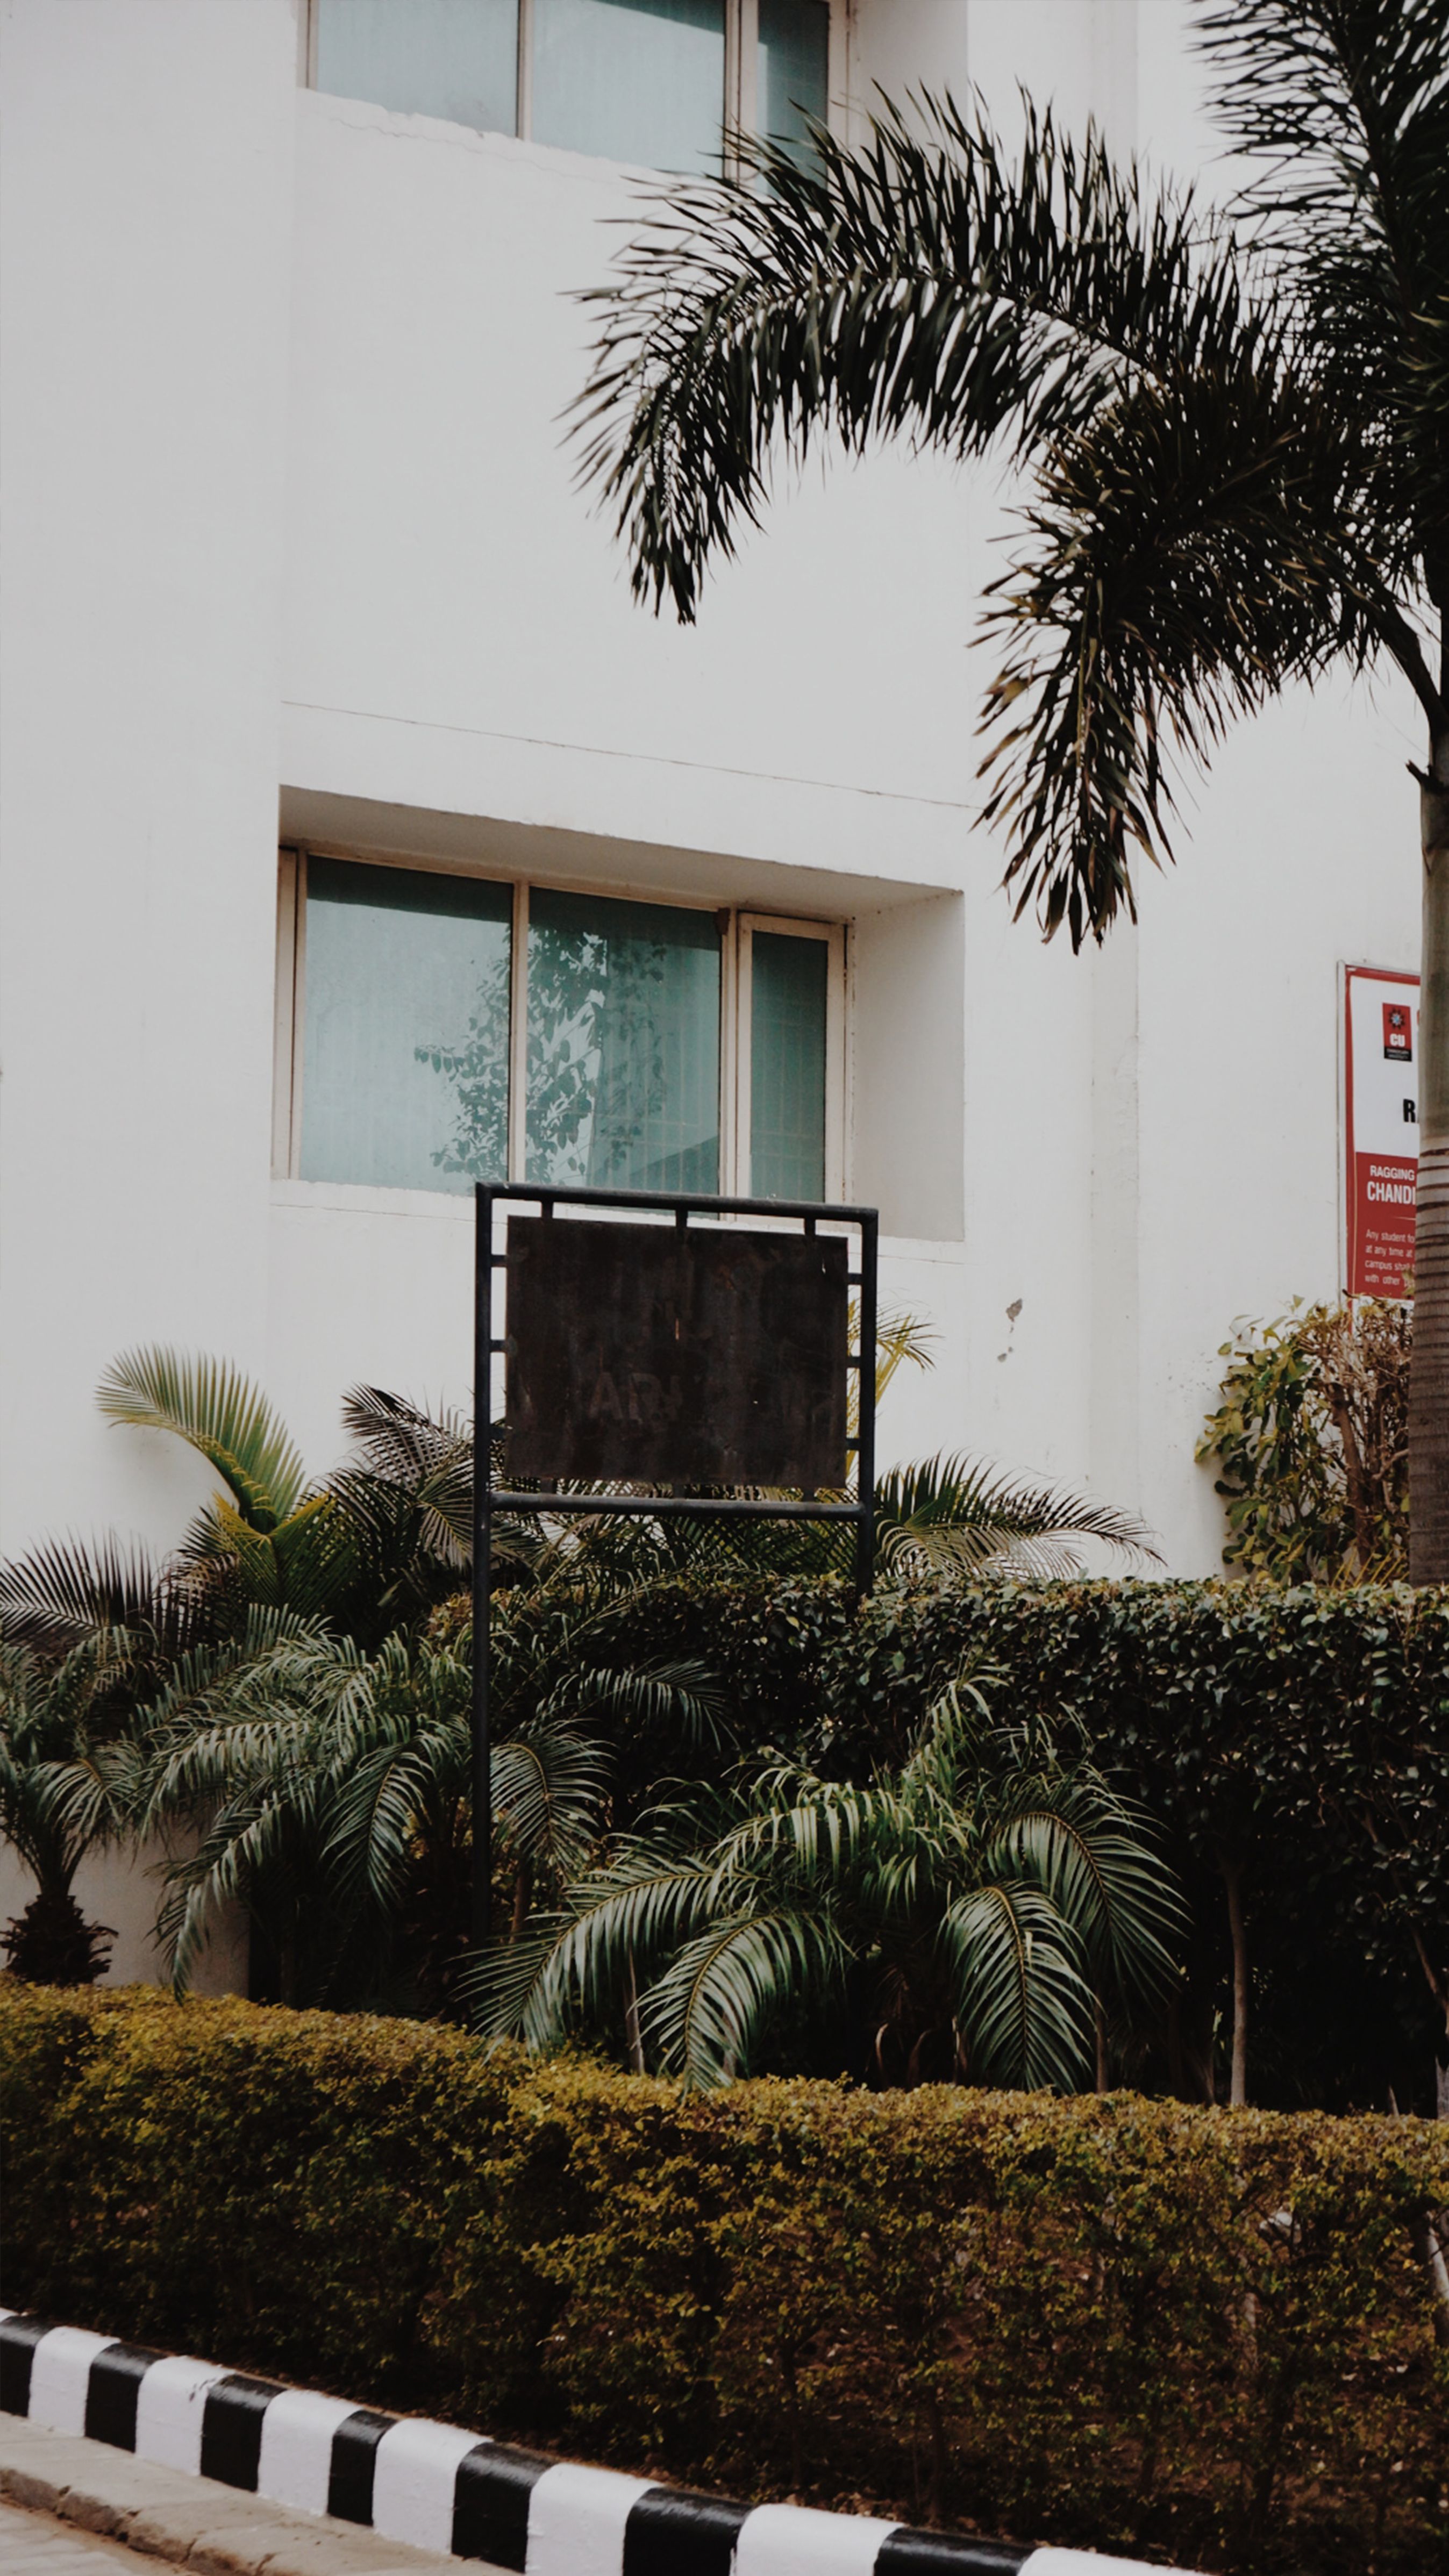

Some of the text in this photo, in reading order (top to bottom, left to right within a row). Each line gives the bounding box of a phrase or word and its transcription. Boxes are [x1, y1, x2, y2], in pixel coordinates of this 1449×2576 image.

[1390, 1033, 1406, 1047] CU
[1403, 1098, 1418, 1124] R
[1371, 1165, 1415, 1181] RAGGING
[1367, 1182, 1416, 1205] CHANDI
[1366, 1229, 1379, 1241] Any
[1381, 1233, 1405, 1242] student
[1366, 1245, 1412, 1258] at any time at
[1365, 1260, 1392, 1271] campus
[1365, 1275, 1379, 1283] with
[1382, 1276, 1400, 1285] other
